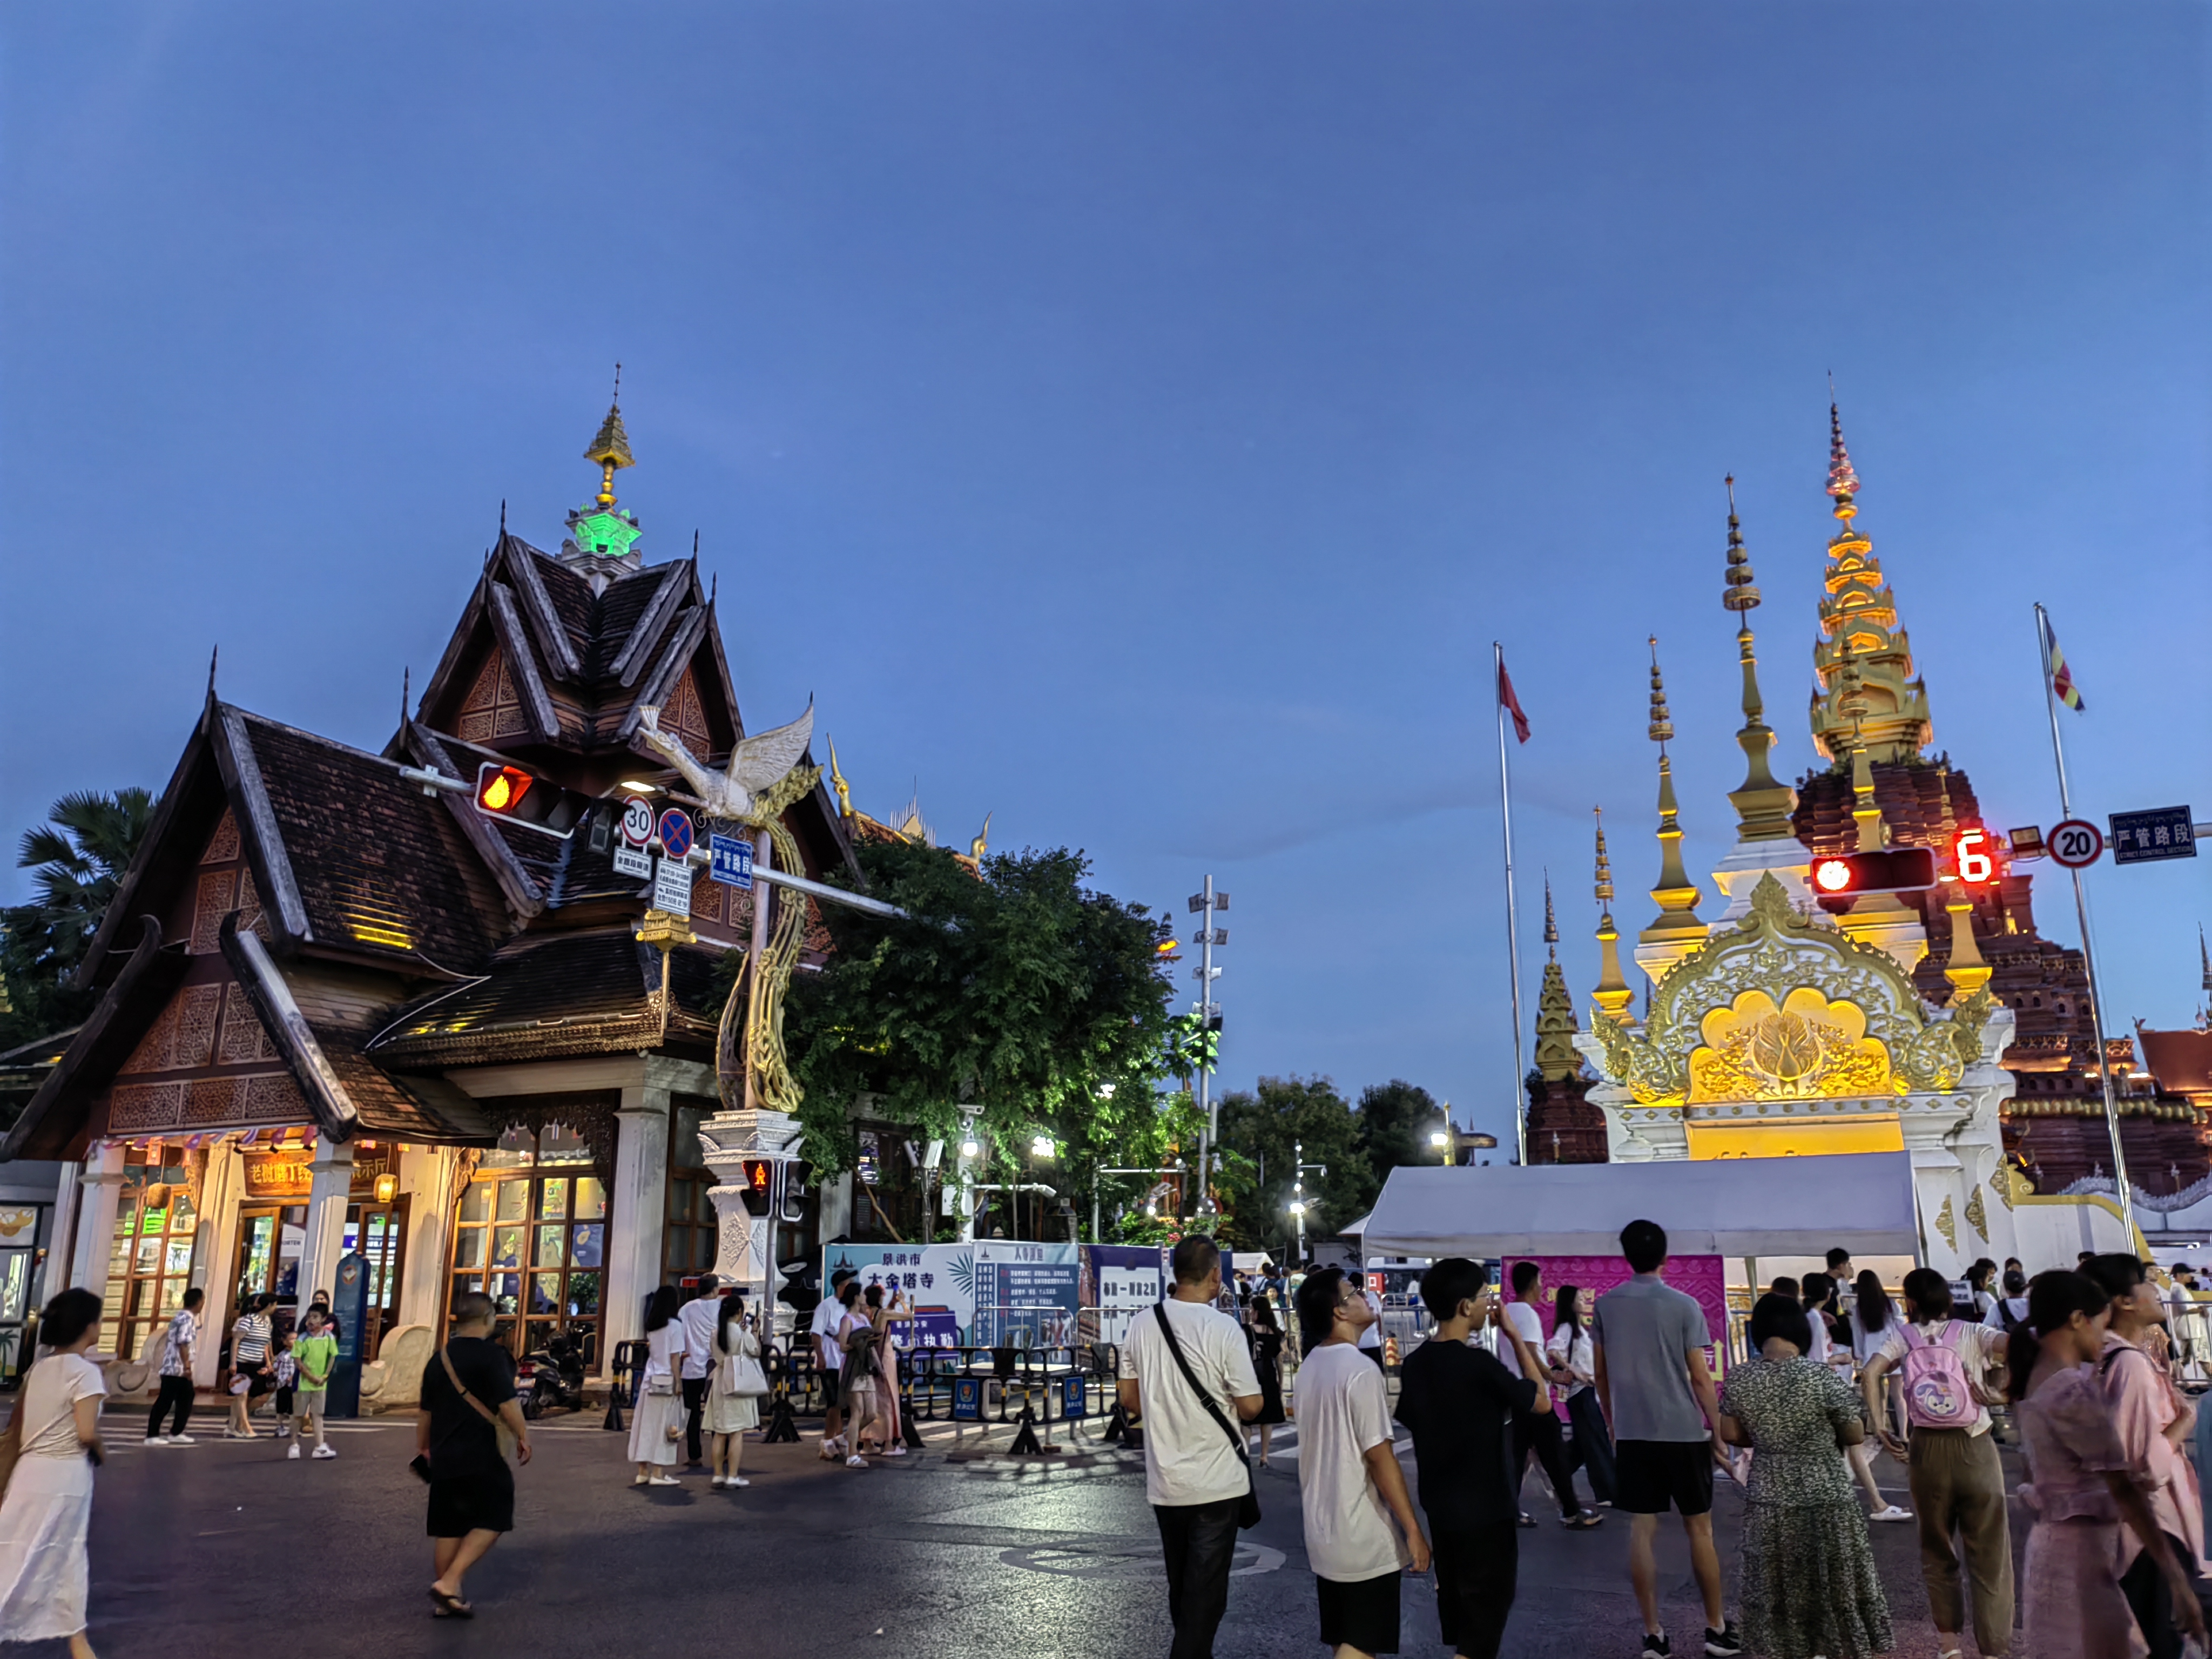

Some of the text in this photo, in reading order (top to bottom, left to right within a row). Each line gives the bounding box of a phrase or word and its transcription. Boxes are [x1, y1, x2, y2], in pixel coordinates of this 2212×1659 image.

[626, 805, 649, 832] 30
[2061, 832, 2090, 857] 20
[2116, 823, 2190, 850] 严管路段
[713, 848, 750, 875] 严管路段
[1957, 835, 1992, 882] 6
[2140, 848, 2166, 857] CONTROL
[2167, 845, 2192, 854] SECTION
[882, 1253, 921, 1266] 景洪市
[867, 1272, 934, 1290] 大金塔寺
[891, 1332, 954, 1348] 警执勤
